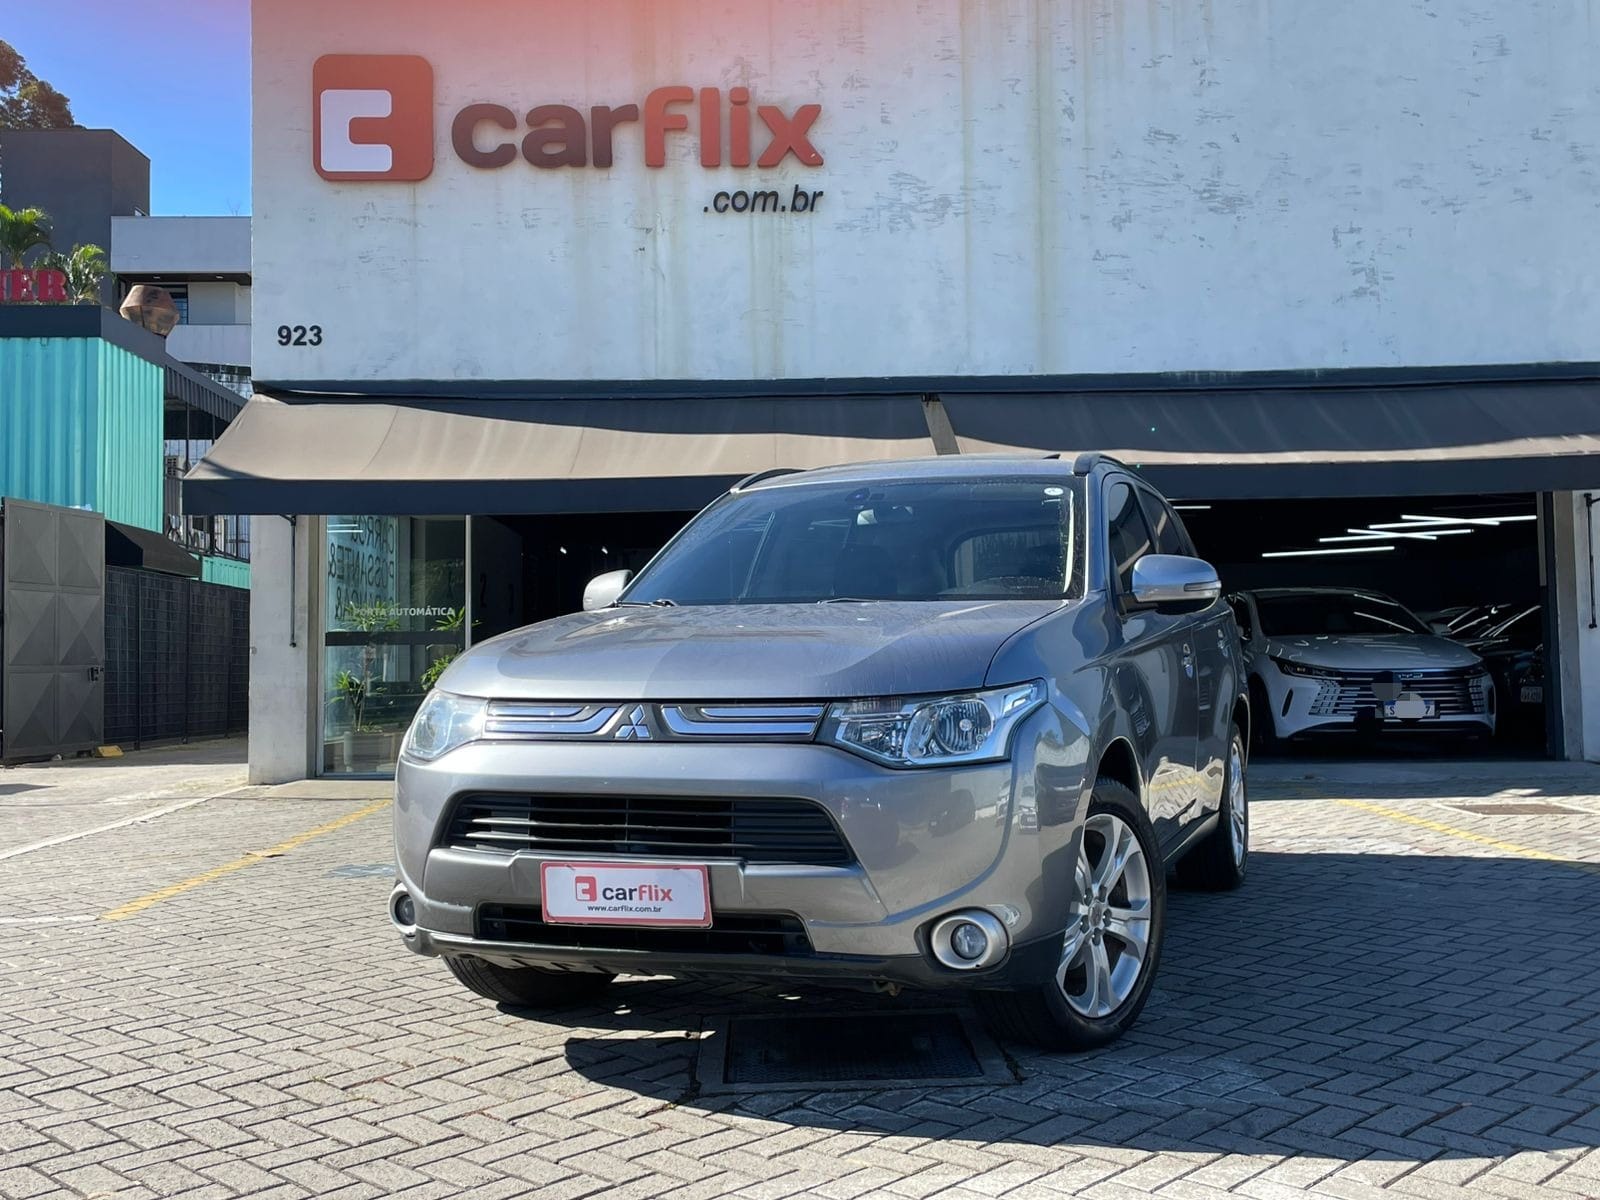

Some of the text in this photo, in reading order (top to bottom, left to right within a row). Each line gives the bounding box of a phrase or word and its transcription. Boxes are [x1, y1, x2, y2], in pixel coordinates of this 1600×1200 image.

[451, 85, 824, 169] carflix
[703, 185, 824, 214] .com.br
[277, 325, 323, 346] 923
[353, 604, 456, 617] PORTA AUTOMÁTICA
[602, 884, 673, 902] carflix
[587, 904, 662, 913] www.carflix.com.br
